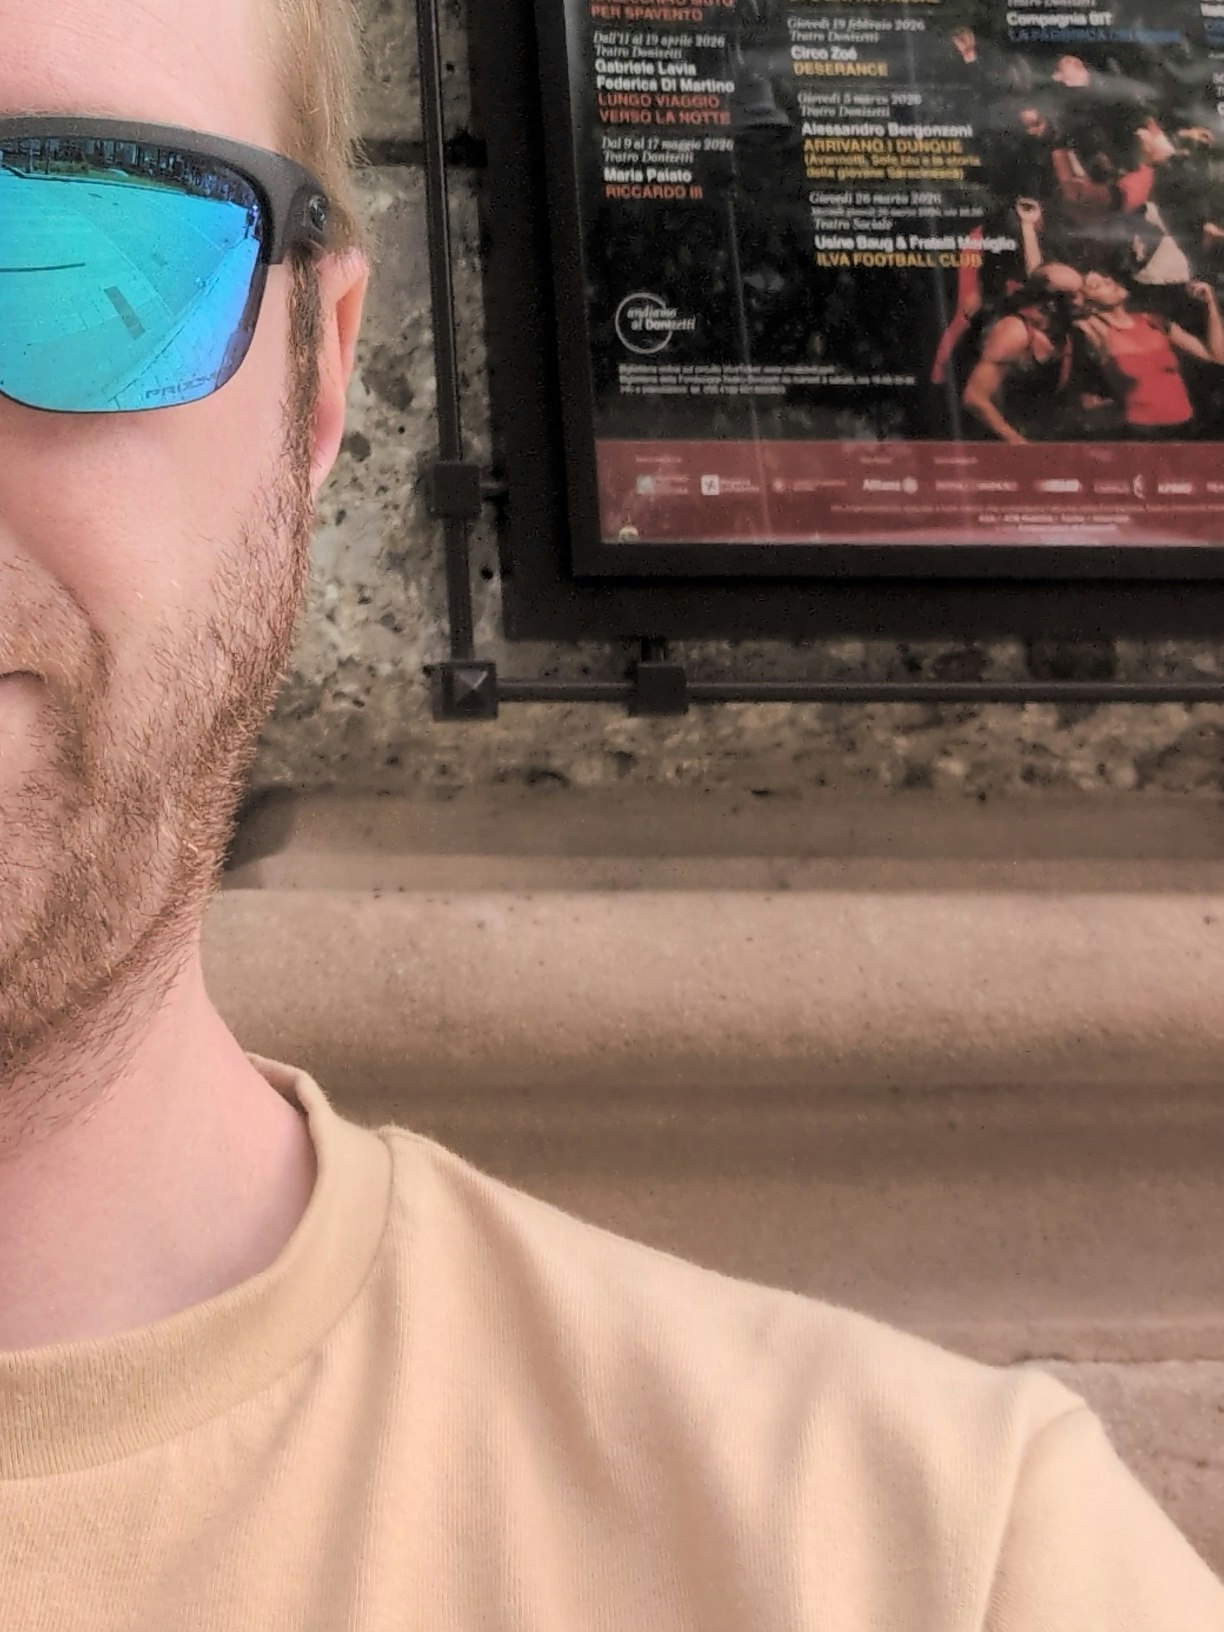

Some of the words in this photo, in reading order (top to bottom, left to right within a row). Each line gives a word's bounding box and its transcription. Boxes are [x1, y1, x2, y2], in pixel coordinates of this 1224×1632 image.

[591, 5, 620, 17] PER
[625, 8, 703, 22] SPAVENTO
[1007, 11, 1087, 28] Compagnia
[895, 19, 925, 31] 2026
[632, 35, 643, 45] al
[661, 35, 692, 49] aprile
[696, 35, 725, 47] 2026
[596, 44, 628, 57] Teatro
[632, 46, 682, 59] Donizetti
[791, 45, 828, 60] Circo
[595, 58, 655, 74] Gabriele
[658, 61, 696, 76] Lavia
[794, 62, 888, 76] DESERANCE
[596, 75, 657, 90] Federica
[680, 79, 735, 92] Martino
[598, 93, 652, 106] LUNGO
[656, 94, 720, 108] VIAGGIO
[599, 110, 651, 123] VERSO
[656, 111, 676, 124] LA
[679, 111, 731, 125] NOTTE
[801, 122, 885, 136] Alessandro
[888, 122, 973, 140] Bergonzoni
[602, 136, 621, 149] Dal
[625, 137, 633, 149] 9
[634, 138, 644, 149] al
[647, 137, 658, 149] 17
[661, 140, 702, 151] maggio
[704, 138, 734, 151] 2026
[804, 139, 883, 152] ARRIVANO
[896, 139, 963, 153] DUNQUE
[603, 151, 638, 163] Teatro
[642, 151, 694, 163] Donizetti
[604, 168, 644, 182] Maria
[647, 168, 692, 182] Paiato
[605, 184, 686, 199] RICCARDO
[690, 186, 703, 199] III
[814, 234, 854, 250] Usine
[856, 235, 893, 252] Baug
[896, 236, 907, 250] &
[909, 236, 956, 250] Fratelli
[817, 252, 850, 267] ILVA
[854, 252, 936, 267] FOOTBALL
[939, 253, 983, 268] CLUB
[627, 305, 677, 319] andiamo
[631, 319, 643, 330] al
